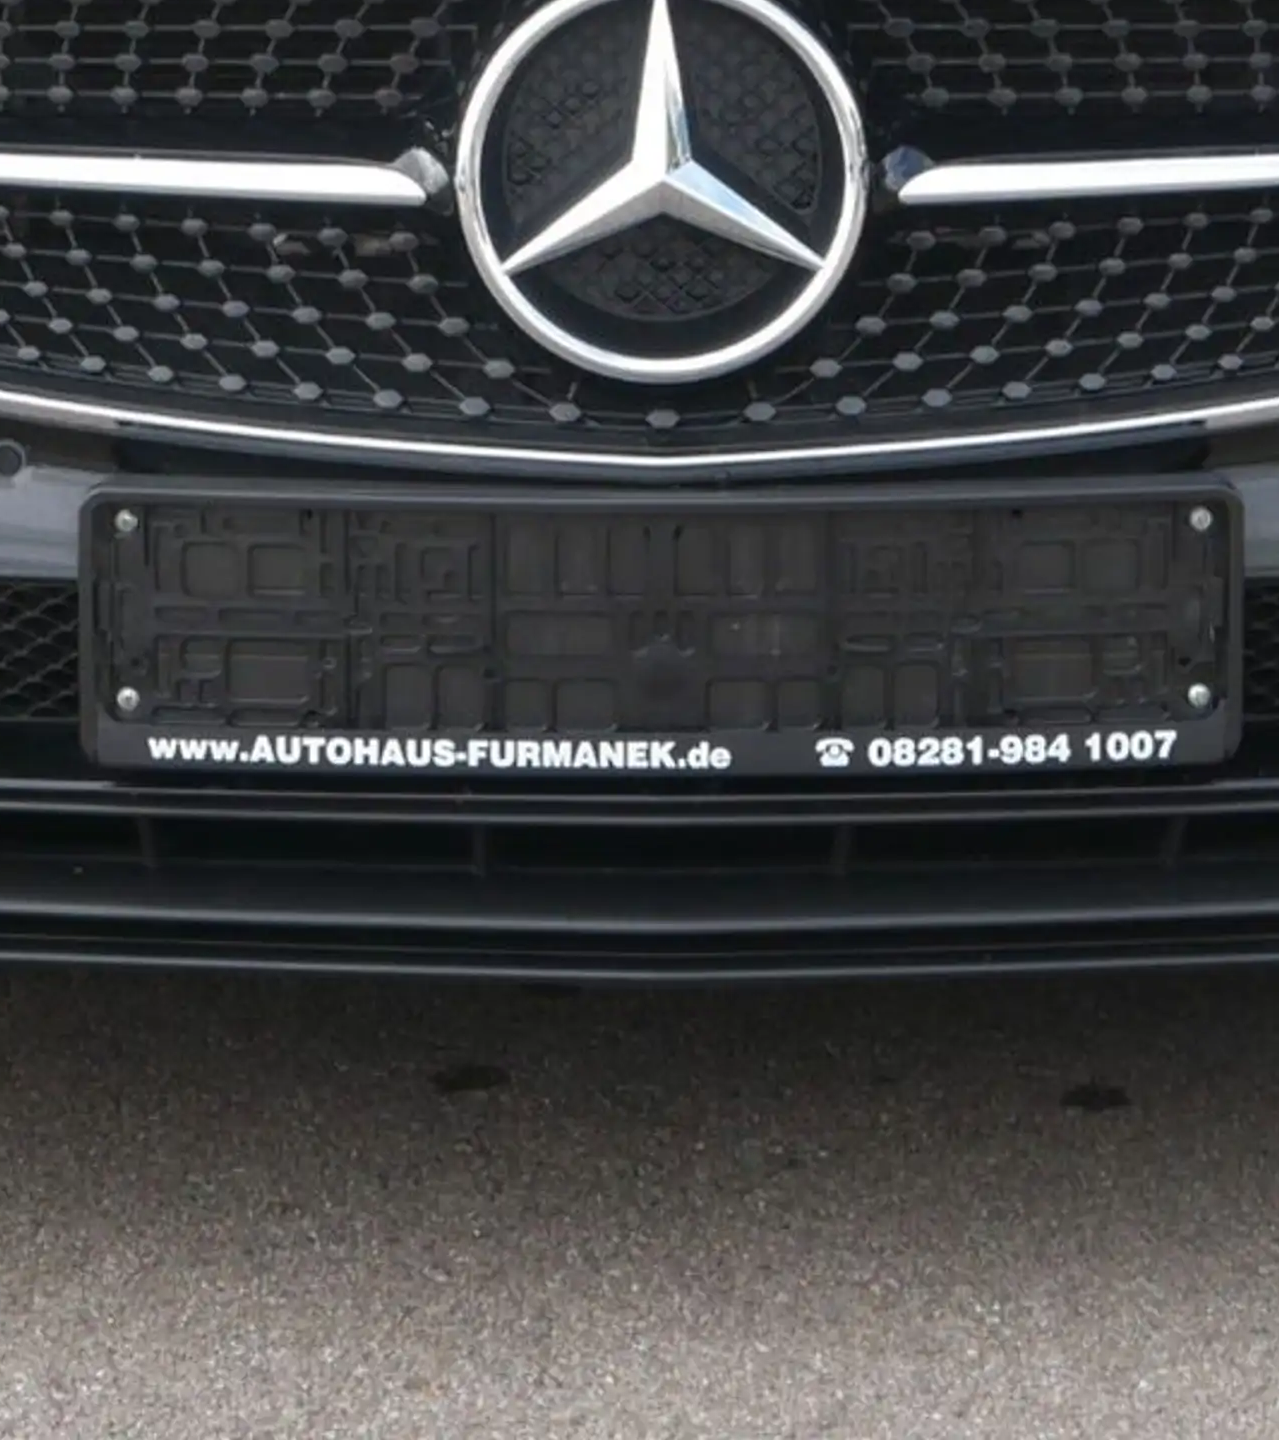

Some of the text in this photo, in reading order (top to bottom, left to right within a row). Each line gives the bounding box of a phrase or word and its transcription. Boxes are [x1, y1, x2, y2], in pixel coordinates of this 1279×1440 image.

[147, 734, 732, 770] www.AUTOHAUS-FURMANEK.de
[867, 729, 1178, 768] 08281-984 1007
